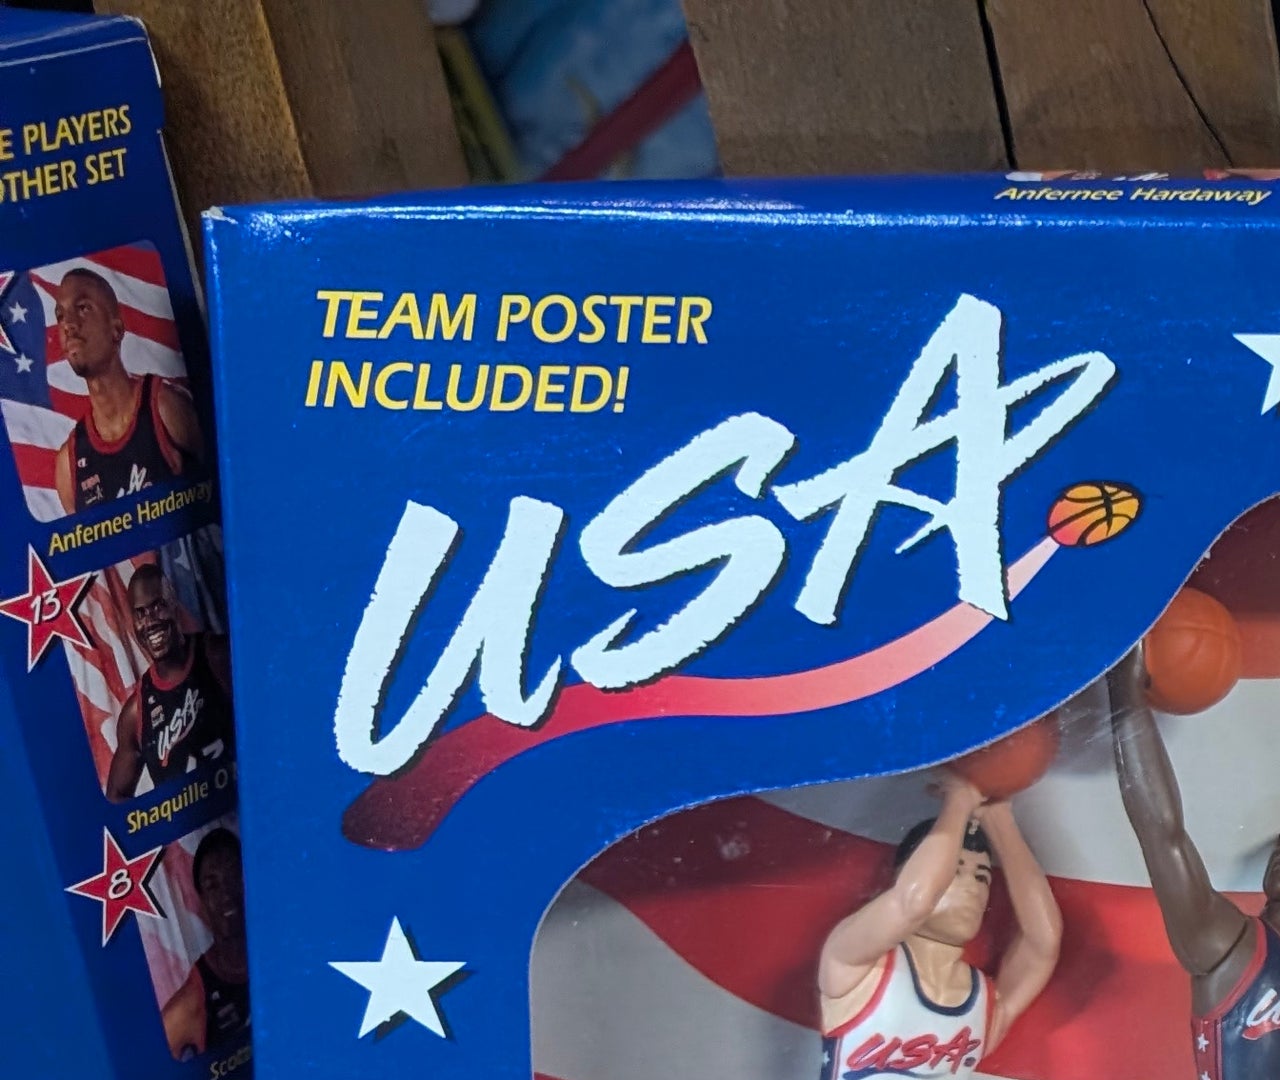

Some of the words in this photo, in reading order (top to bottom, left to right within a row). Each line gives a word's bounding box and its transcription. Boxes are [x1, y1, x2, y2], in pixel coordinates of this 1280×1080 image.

[23, 104, 131, 155] PLAYERS
[85, 148, 127, 185] SET
[993, 186, 1124, 201] Anfernee
[1129, 186, 1272, 206] Hardaway
[317, 290, 477, 341] TEAM
[496, 294, 712, 345] POSTER
[305, 359, 629, 414] INCLUDED!
[49, 512, 132, 557] Anfernee
[137, 480, 213, 525] Hardaway
[333, 294, 1116, 774] USA
[30, 589, 61, 625] 13
[127, 782, 208, 834] Shaquille
[109, 869, 132, 899] 8
[847, 1026, 981, 1074] USA
